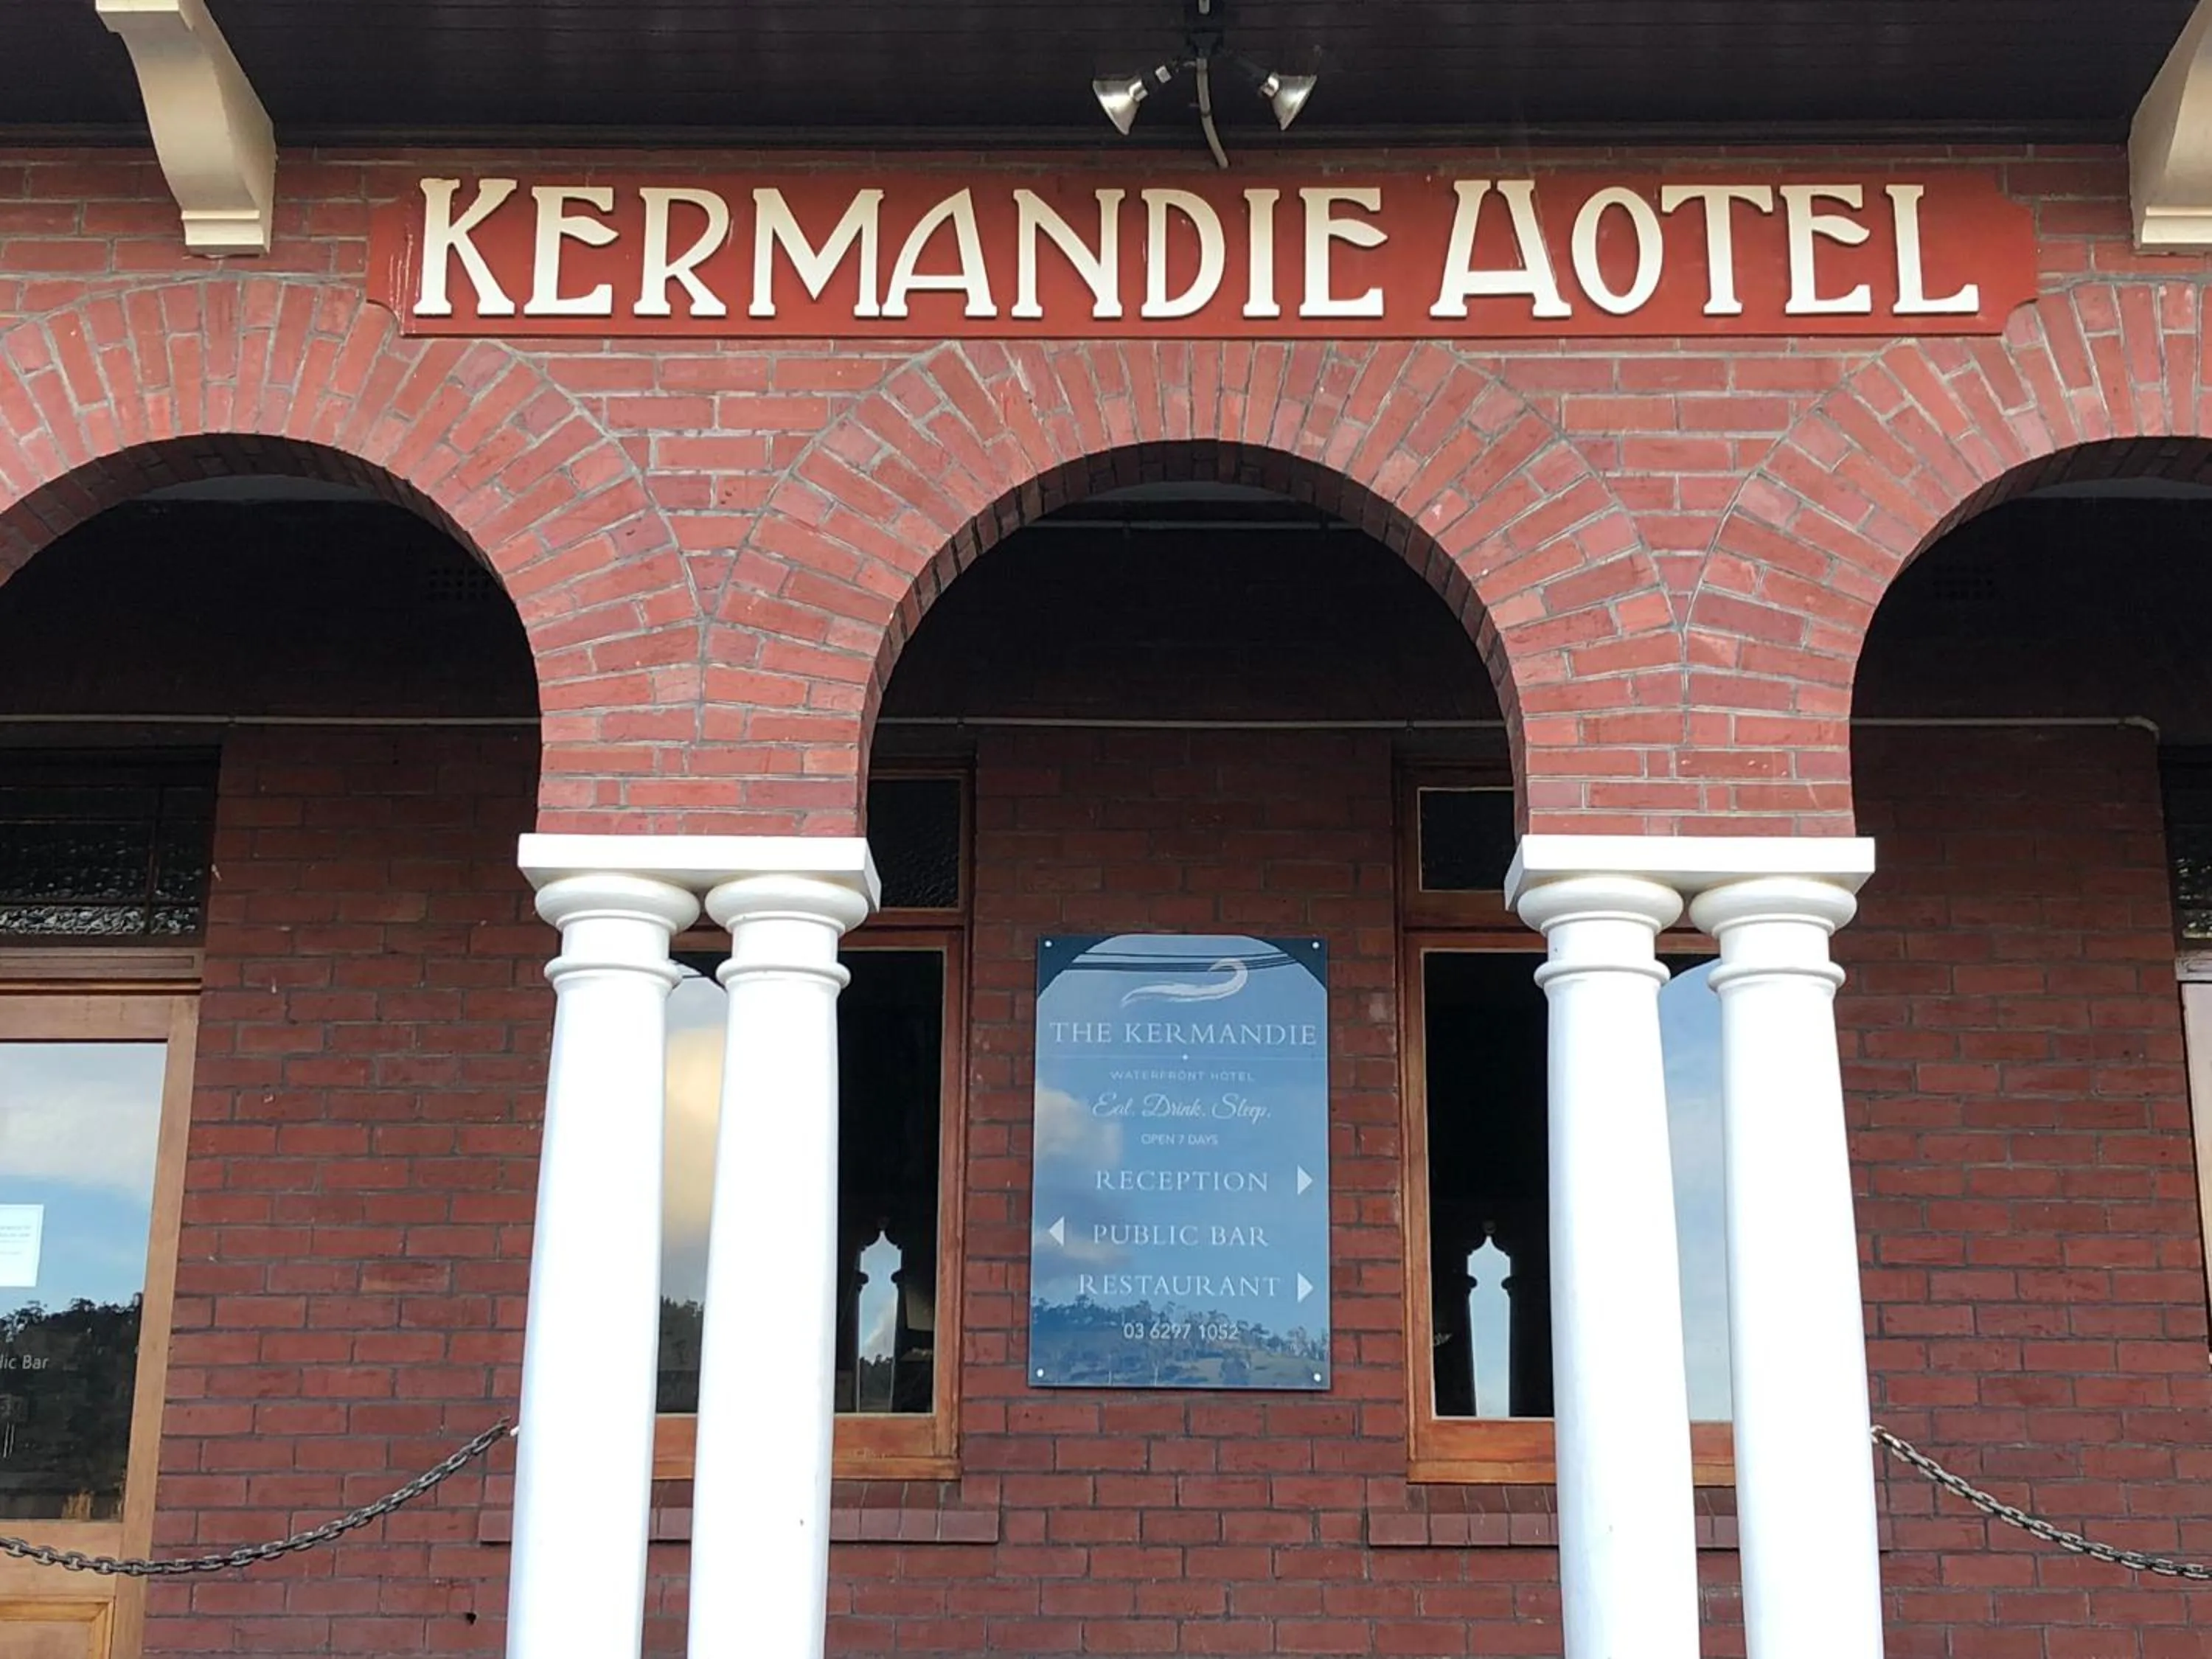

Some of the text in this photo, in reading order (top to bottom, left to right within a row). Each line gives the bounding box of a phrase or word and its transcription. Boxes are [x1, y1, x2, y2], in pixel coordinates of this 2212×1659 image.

[413, 178, 1388, 317] KERMANDIE
[1050, 1023, 1317, 1046] THE KERMANDIE
[1109, 1071, 1255, 1082] WATERFRONT HOTEL
[1141, 1133, 1219, 1146] OPEN 7 DAYS
[1096, 1170, 1269, 1192] RECEPTION
[1093, 1224, 1269, 1247] PUBLIC BAR
[1078, 1273, 1281, 1297] RESTAURANT
[1123, 1324, 1240, 1340] 03 6297 1052
[22, 1354, 49, 1370] Bar
